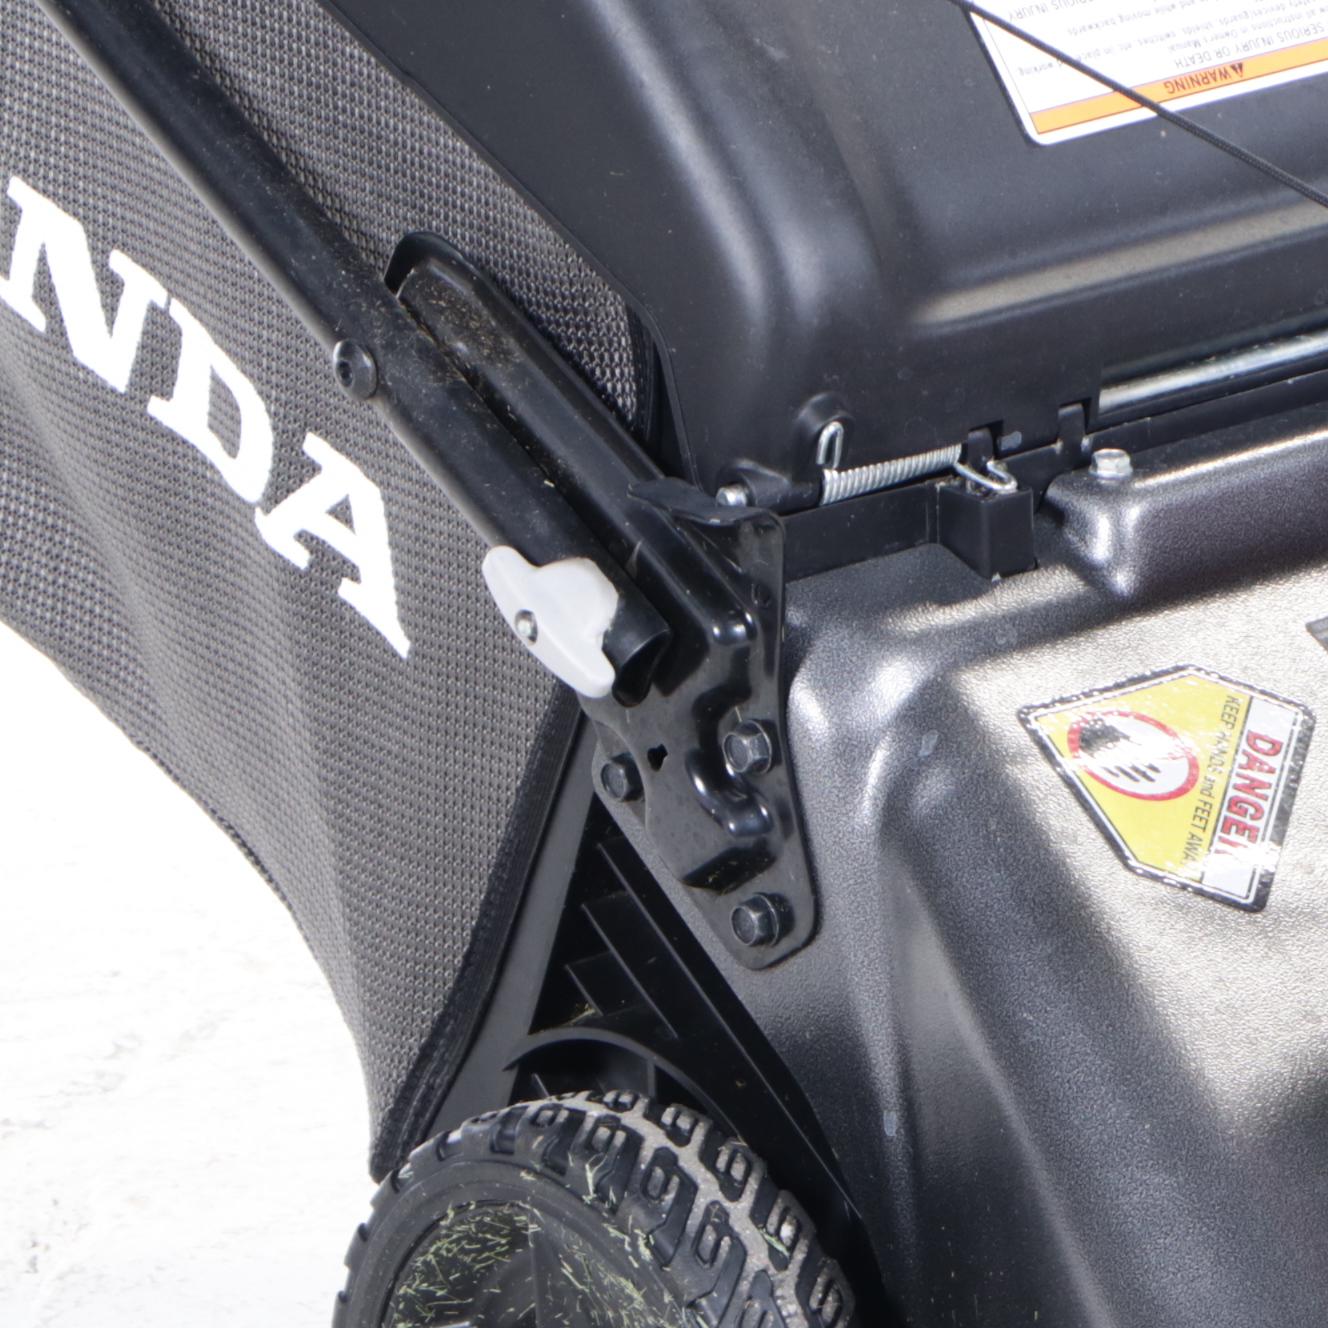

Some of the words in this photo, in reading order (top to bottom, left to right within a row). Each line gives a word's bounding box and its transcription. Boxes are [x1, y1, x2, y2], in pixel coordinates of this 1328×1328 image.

[1276, 22, 1324, 44] SERIOUS
[1214, 46, 1231, 59] OR
[1235, 37, 1274, 55] INJURY
[1173, 50, 1212, 69] DEATH
[1163, 67, 1231, 95] WARNING
[1221, 695, 1241, 731] KEEP
[1200, 774, 1216, 797] and
[1192, 797, 1213, 833] FEET
[1181, 831, 1204, 865] AWA
